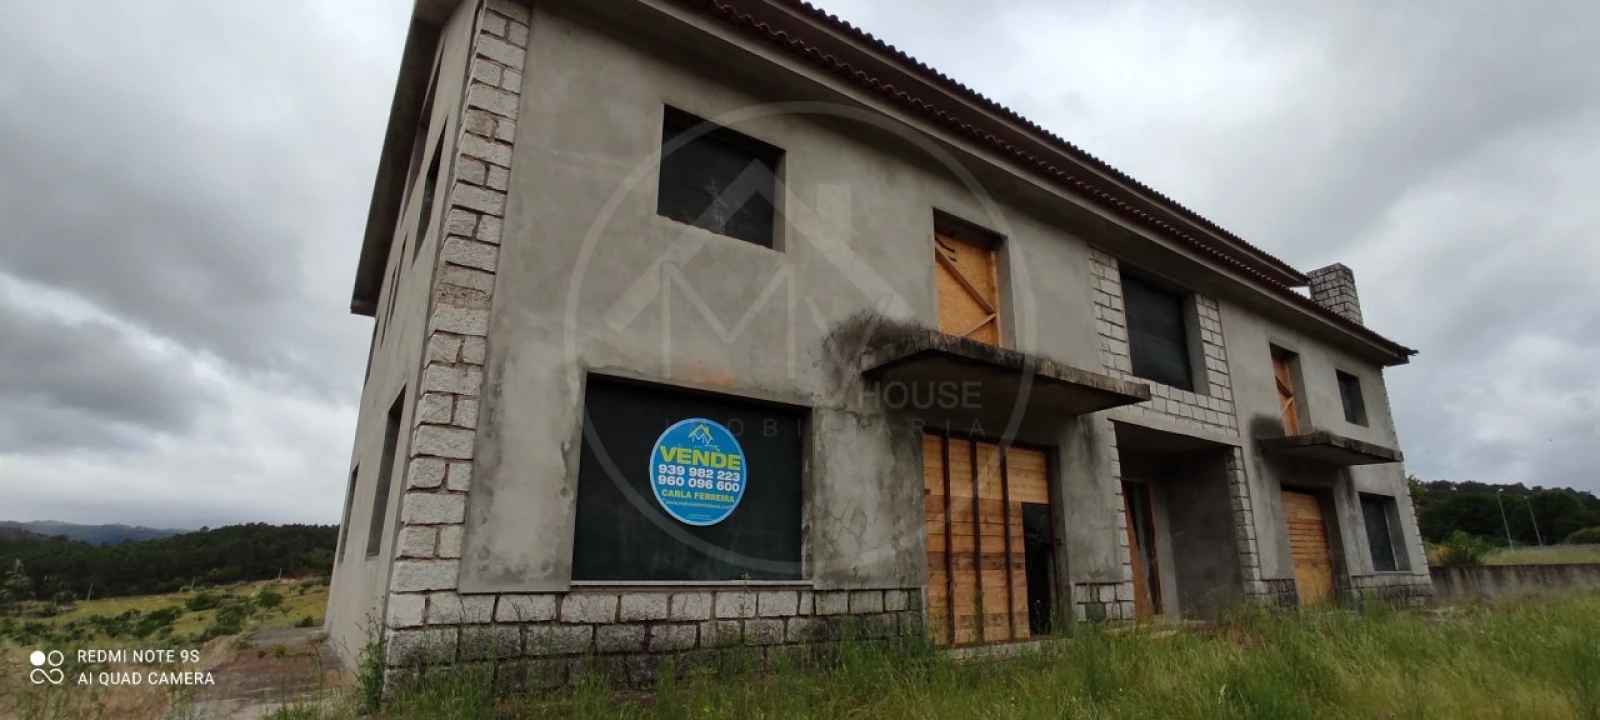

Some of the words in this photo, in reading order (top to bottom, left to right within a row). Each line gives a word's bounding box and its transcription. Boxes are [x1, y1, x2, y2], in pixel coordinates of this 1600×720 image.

[660, 445, 741, 471] VENDE
[658, 464, 686, 476] 939
[688, 467, 714, 479] 982
[716, 470, 740, 482] 223
[658, 475, 685, 486] 960
[688, 478, 714, 490] 096
[716, 481, 740, 492] 600
[661, 489, 692, 499] CARLA
[694, 491, 735, 503] FERREIRA
